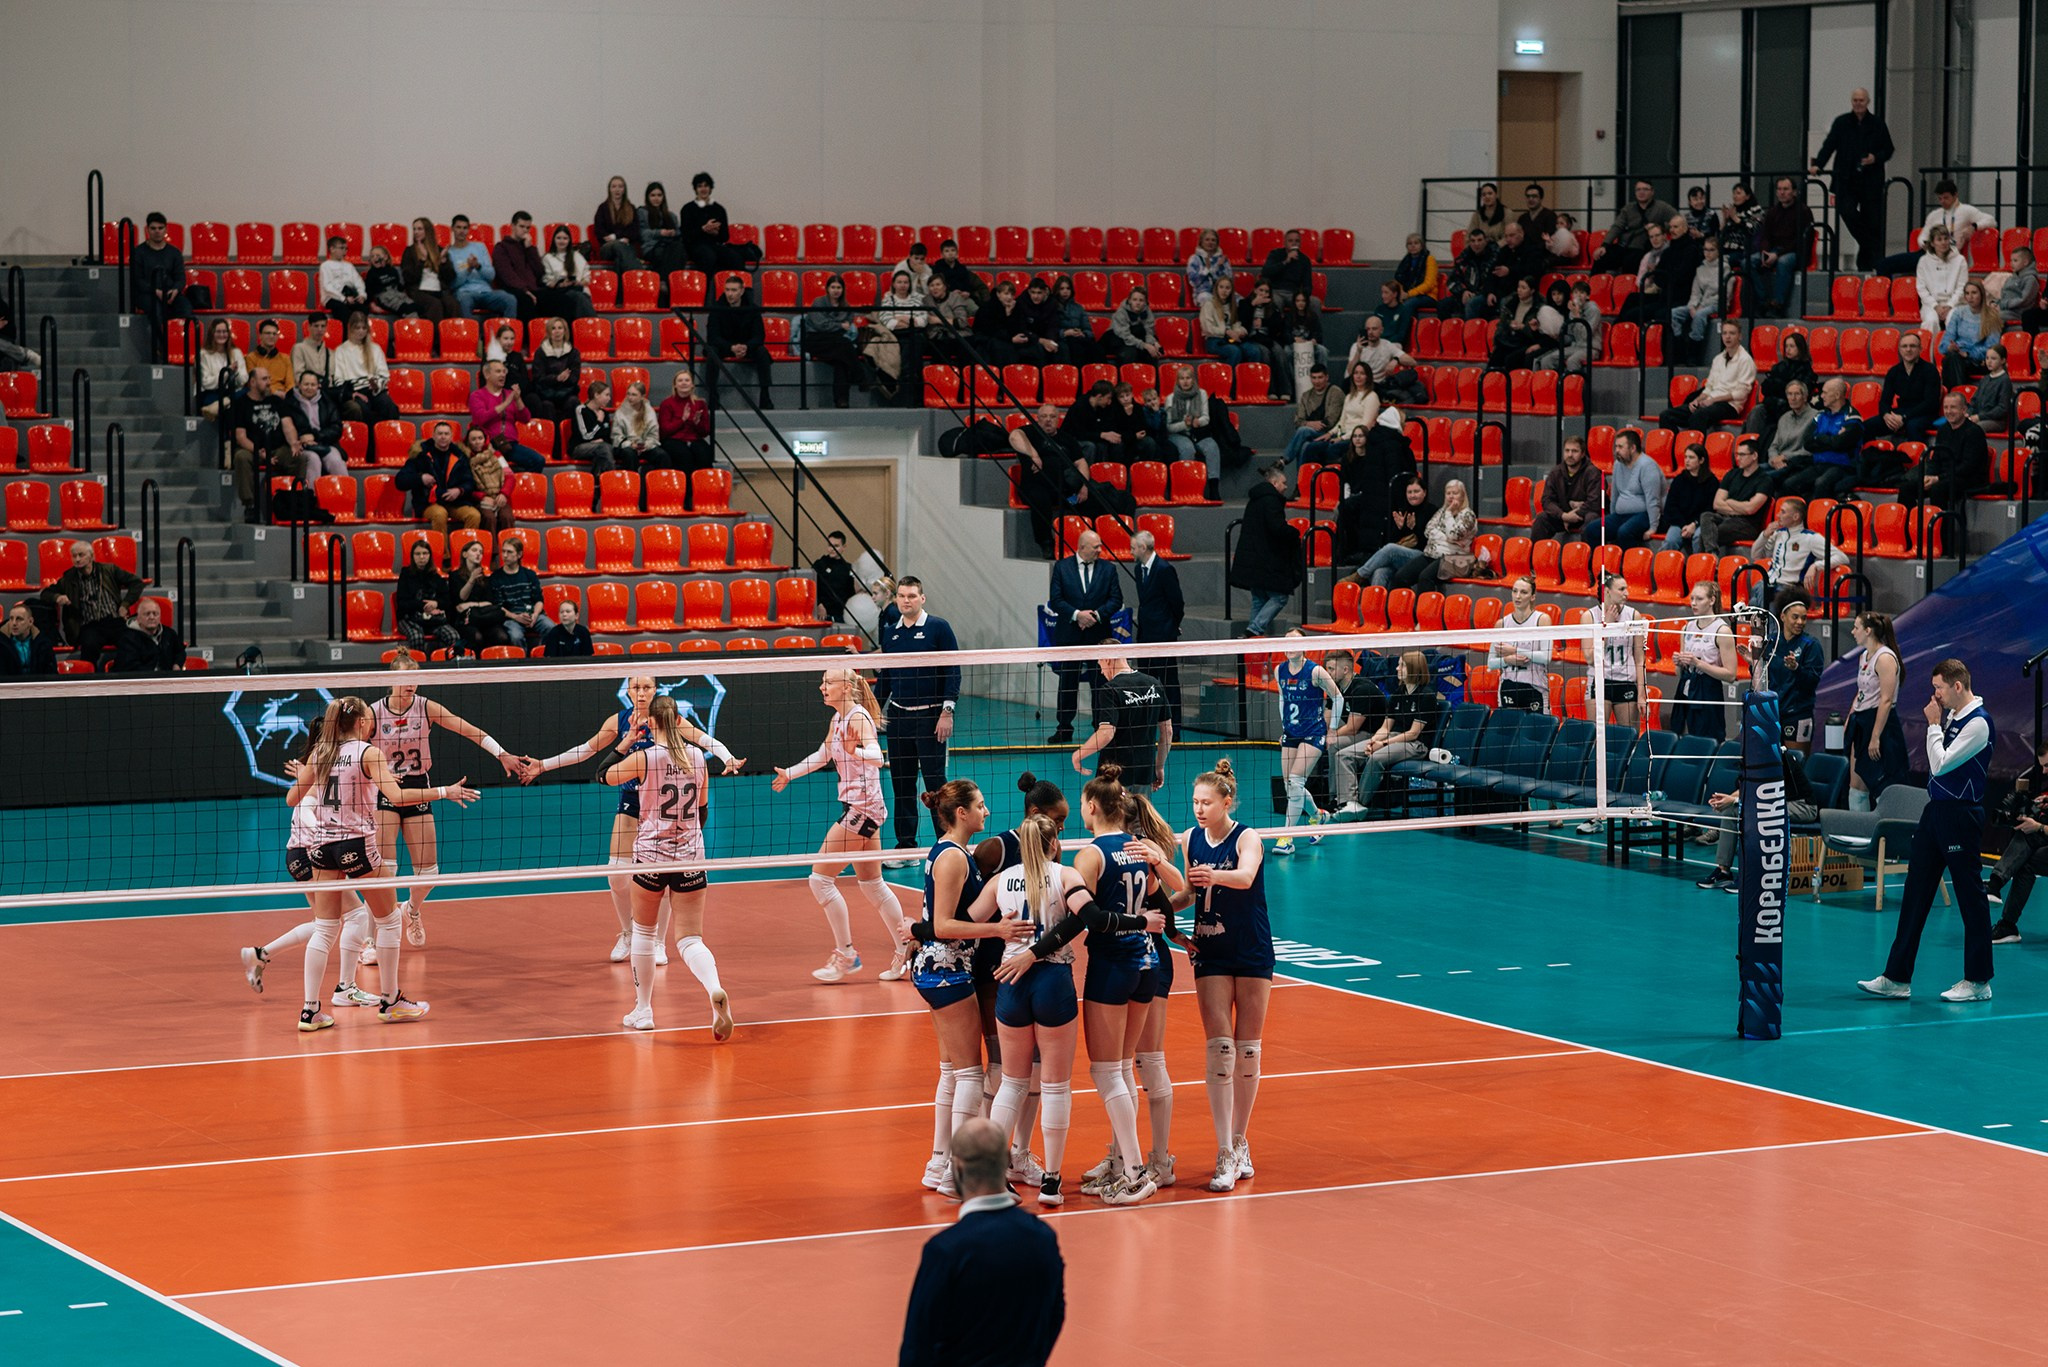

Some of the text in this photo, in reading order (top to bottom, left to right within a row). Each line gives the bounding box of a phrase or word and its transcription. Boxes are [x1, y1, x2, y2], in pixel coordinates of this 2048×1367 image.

[1607, 645, 1624, 665] 11
[1503, 696, 1514, 704] 12
[1289, 703, 1299, 725] 2
[392, 748, 422, 774] 23
[322, 776, 341, 812] 4
[659, 783, 697, 820] 22
[623, 802, 630, 811] 7
[1754, 780, 1785, 943] КОРАБЕЛКА
[1122, 870, 1147, 915] 12
[1791, 873, 1847, 890] DAPOL
